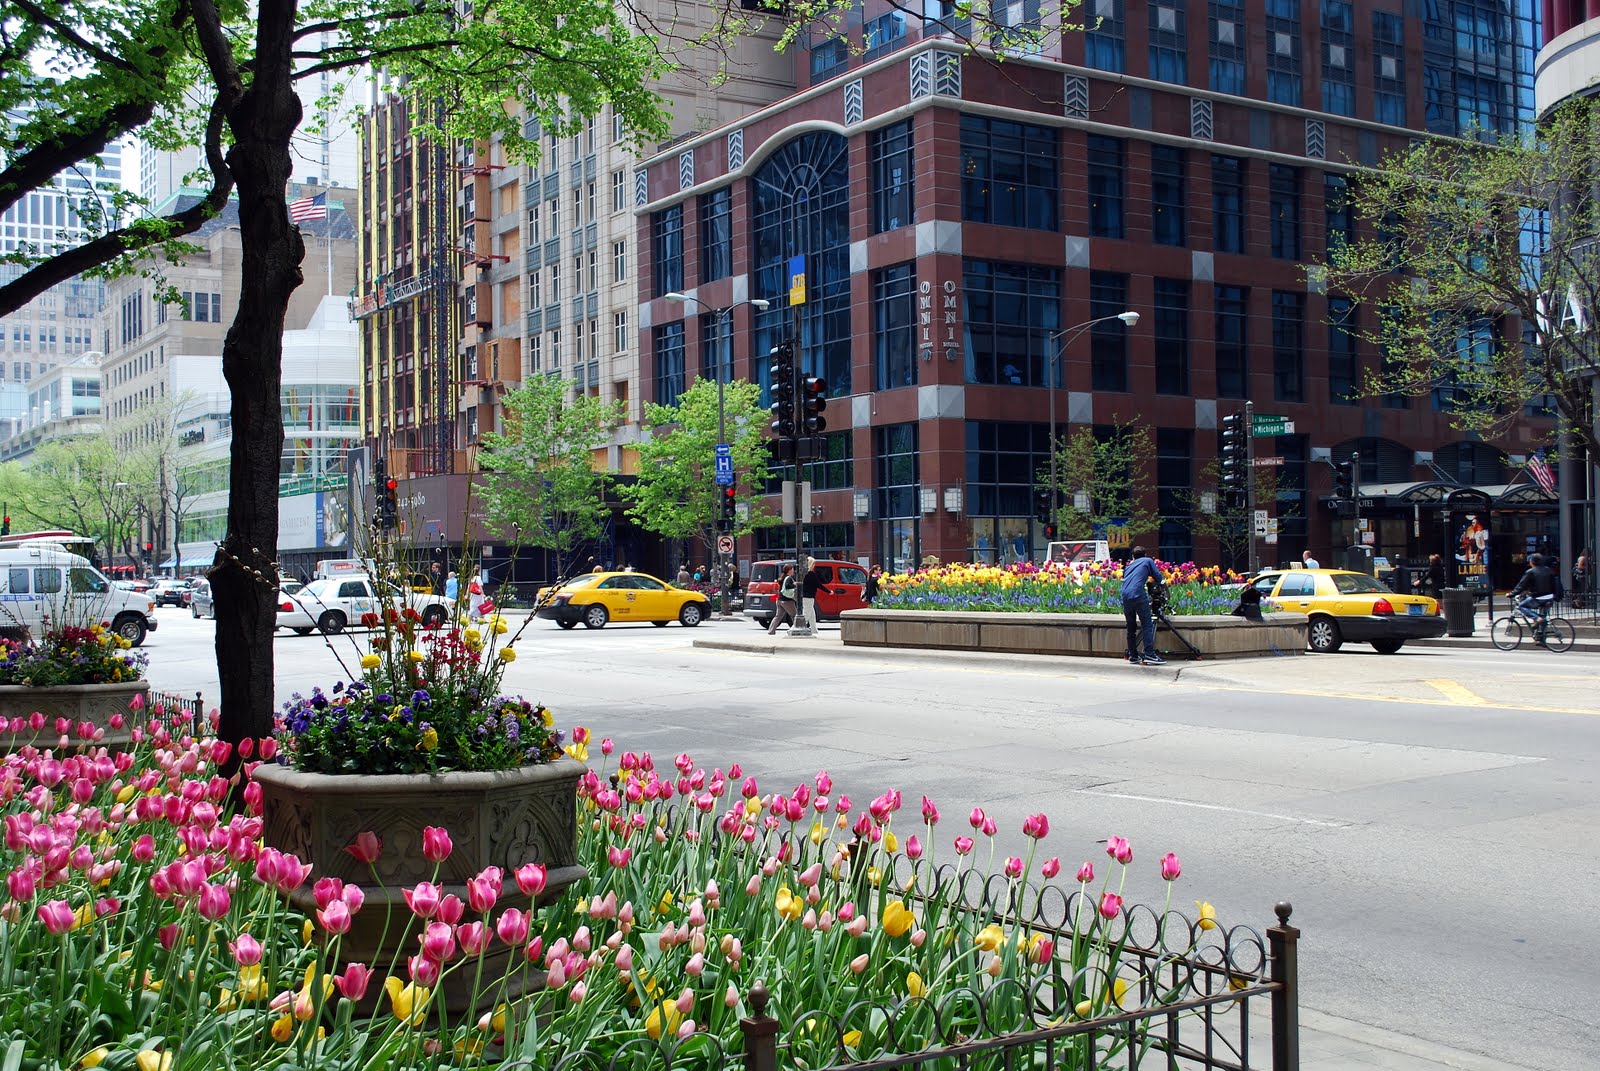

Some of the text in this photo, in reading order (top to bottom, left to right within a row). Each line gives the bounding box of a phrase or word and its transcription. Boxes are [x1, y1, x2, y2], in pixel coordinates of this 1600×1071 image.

[920, 280, 931, 340] OMNI
[944, 280, 957, 340] OMNI
[1258, 425, 1280, 434] Michigan
[718, 457, 729, 471] H
[1358, 500, 1374, 508] OTEL
